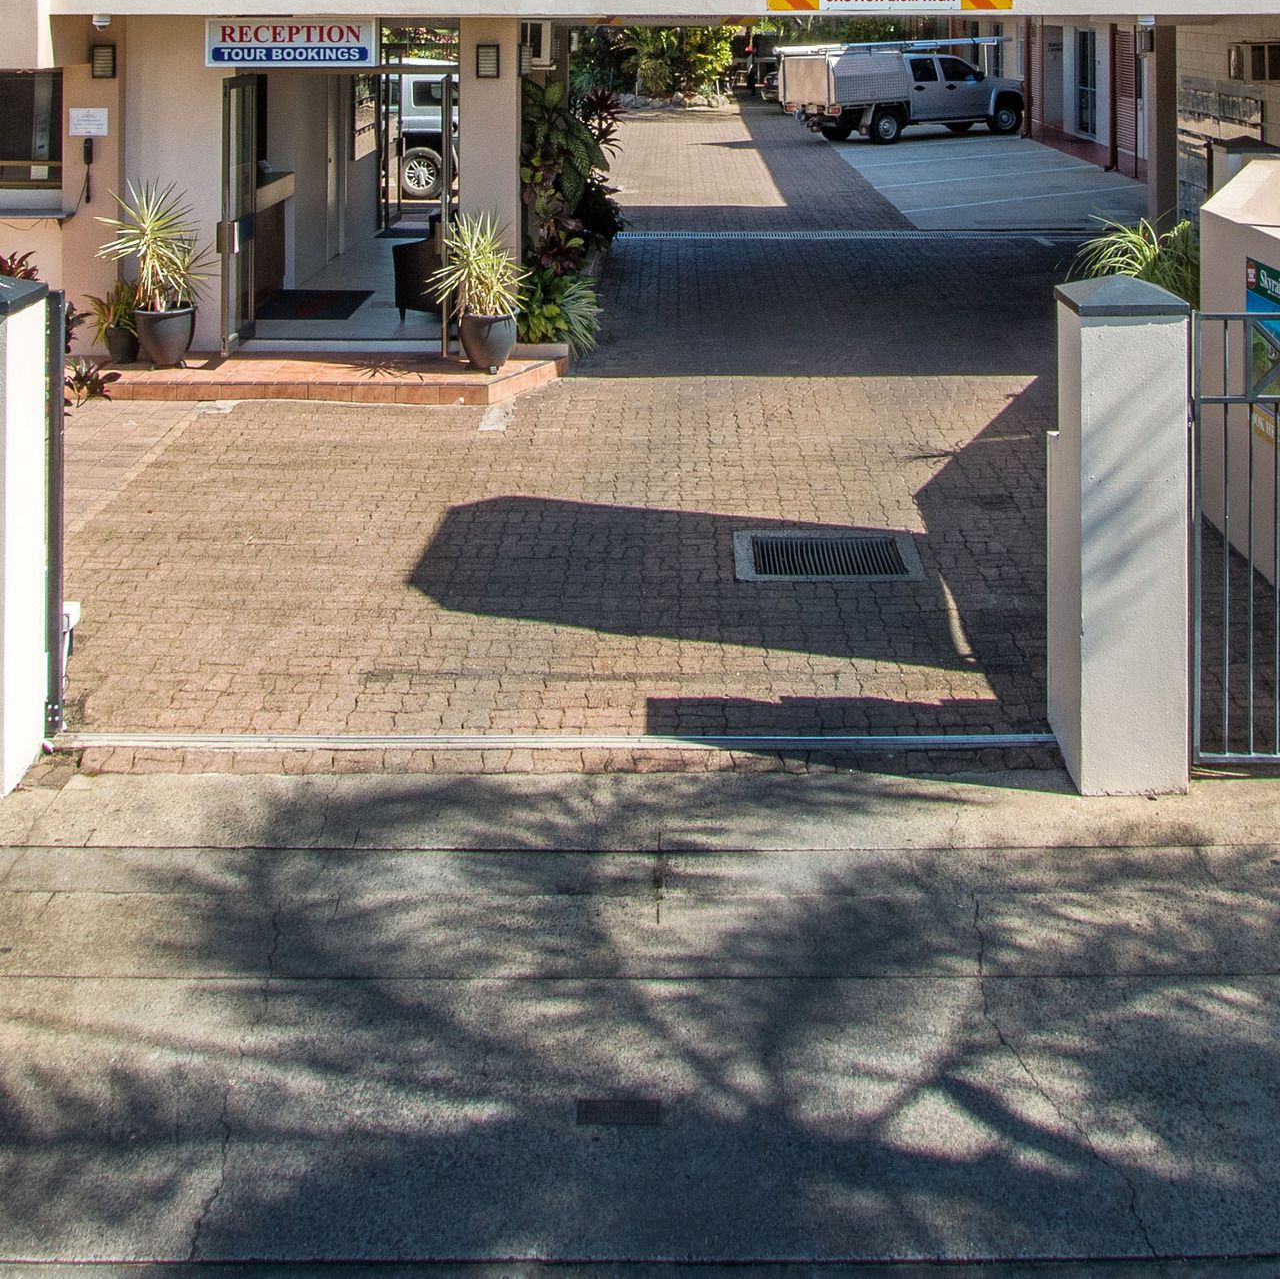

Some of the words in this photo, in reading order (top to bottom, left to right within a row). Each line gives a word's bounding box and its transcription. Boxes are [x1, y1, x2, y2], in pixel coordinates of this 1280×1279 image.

[219, 25, 362, 44] RECEPTION
[221, 48, 267, 61] TOUR
[272, 48, 360, 61] BOOKINGS
